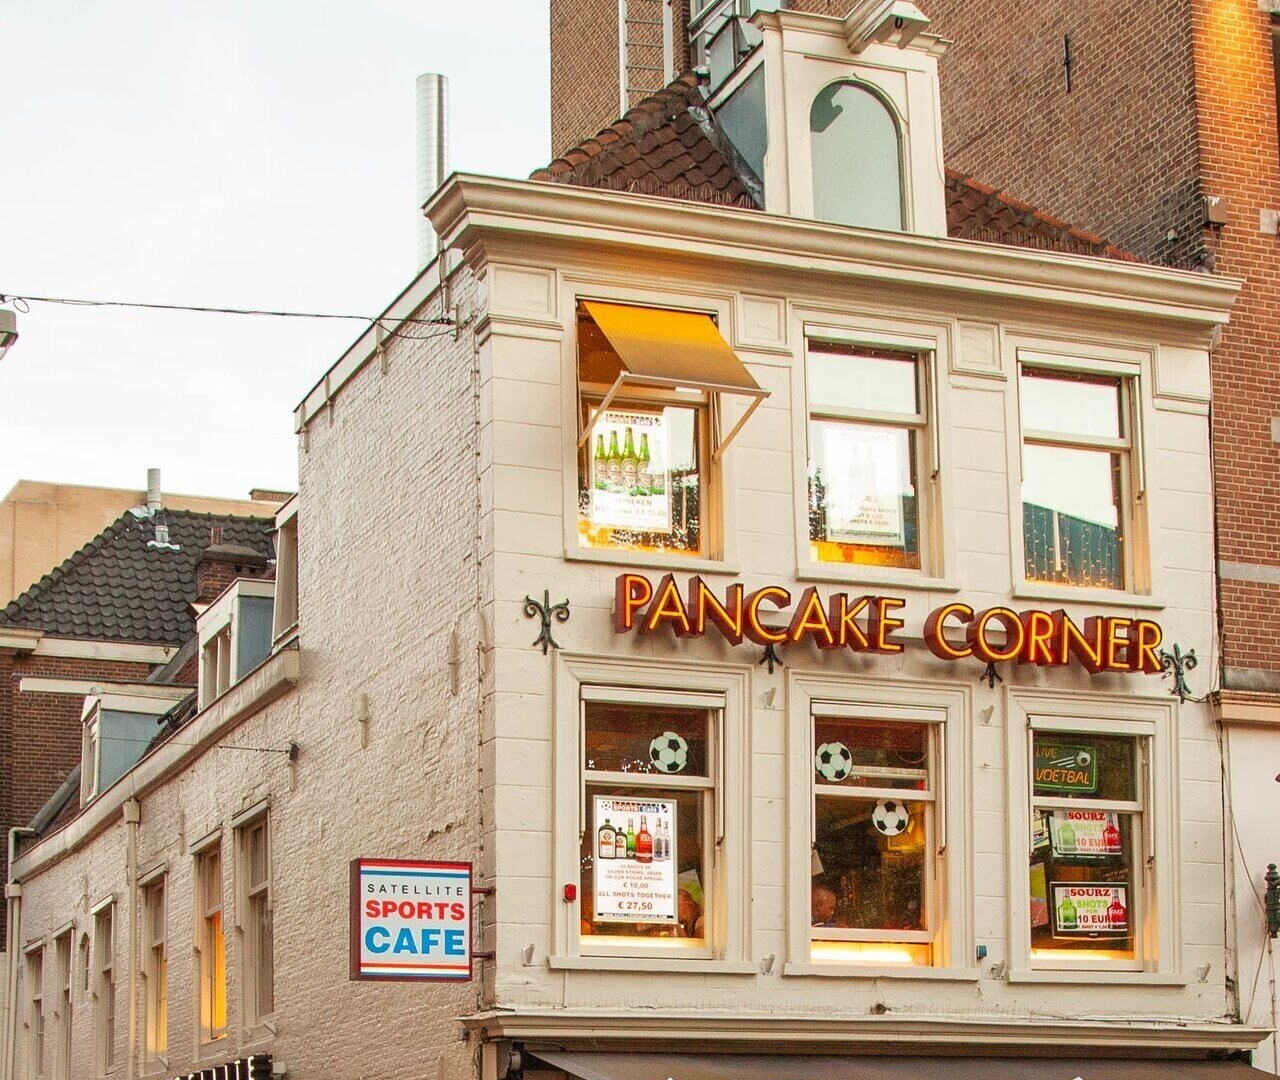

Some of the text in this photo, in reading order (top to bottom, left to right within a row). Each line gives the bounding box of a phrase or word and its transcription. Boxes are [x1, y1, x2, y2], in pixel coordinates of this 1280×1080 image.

[616, 573, 1164, 674] PANCAKE CORNER
[1035, 747, 1058, 759] LIVE
[1035, 768, 1090, 785] VOETBAL
[1067, 811, 1106, 821] SOURZ
[1076, 838, 1087, 847] 10
[367, 883, 464, 896] SATELLITE
[1069, 888, 1111, 898] SOURZ
[612, 891, 635, 899] SHOTS
[626, 901, 654, 911] 27,50
[1076, 899, 1109, 909] SHOTS
[365, 899, 466, 921] SPORTS
[1077, 914, 1088, 924] 10
[364, 925, 466, 956] CAFE
